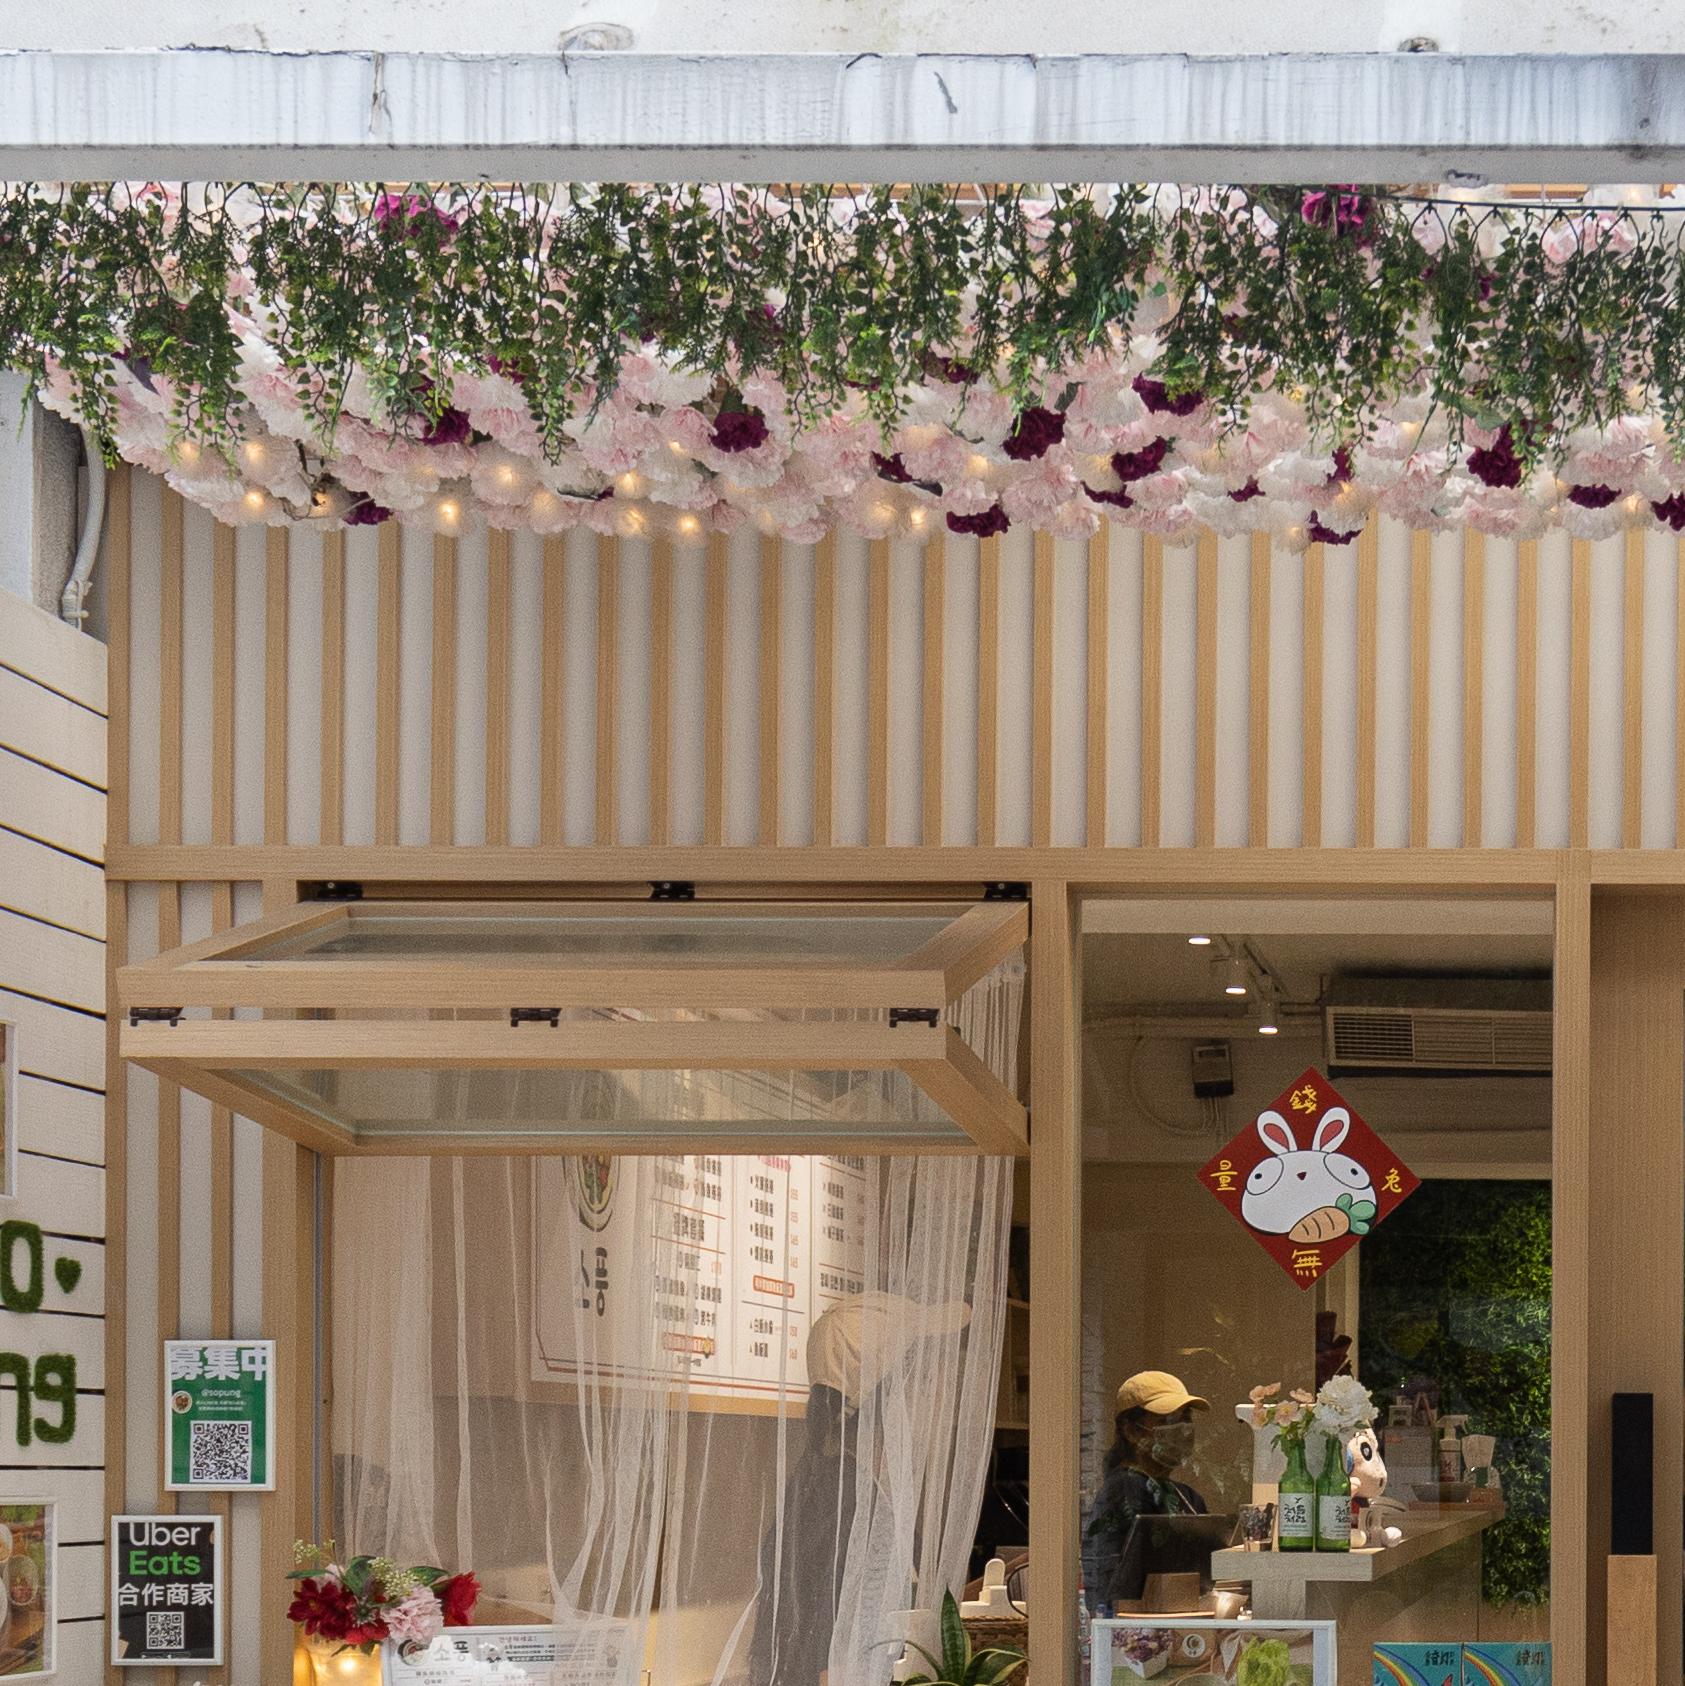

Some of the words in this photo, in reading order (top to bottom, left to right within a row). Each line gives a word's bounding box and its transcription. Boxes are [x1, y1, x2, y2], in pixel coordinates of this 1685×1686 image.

[1290, 1084, 1318, 1114] 錢
[1210, 1160, 1238, 1191] 量
[1382, 1168, 1403, 1193] 兔
[1292, 1249, 1323, 1278] 無
[171, 1346, 267, 1381] 募集中
[129, 1522, 200, 1546] Uber
[129, 1551, 201, 1575] Eats
[118, 1582, 214, 1606] 合作商家
